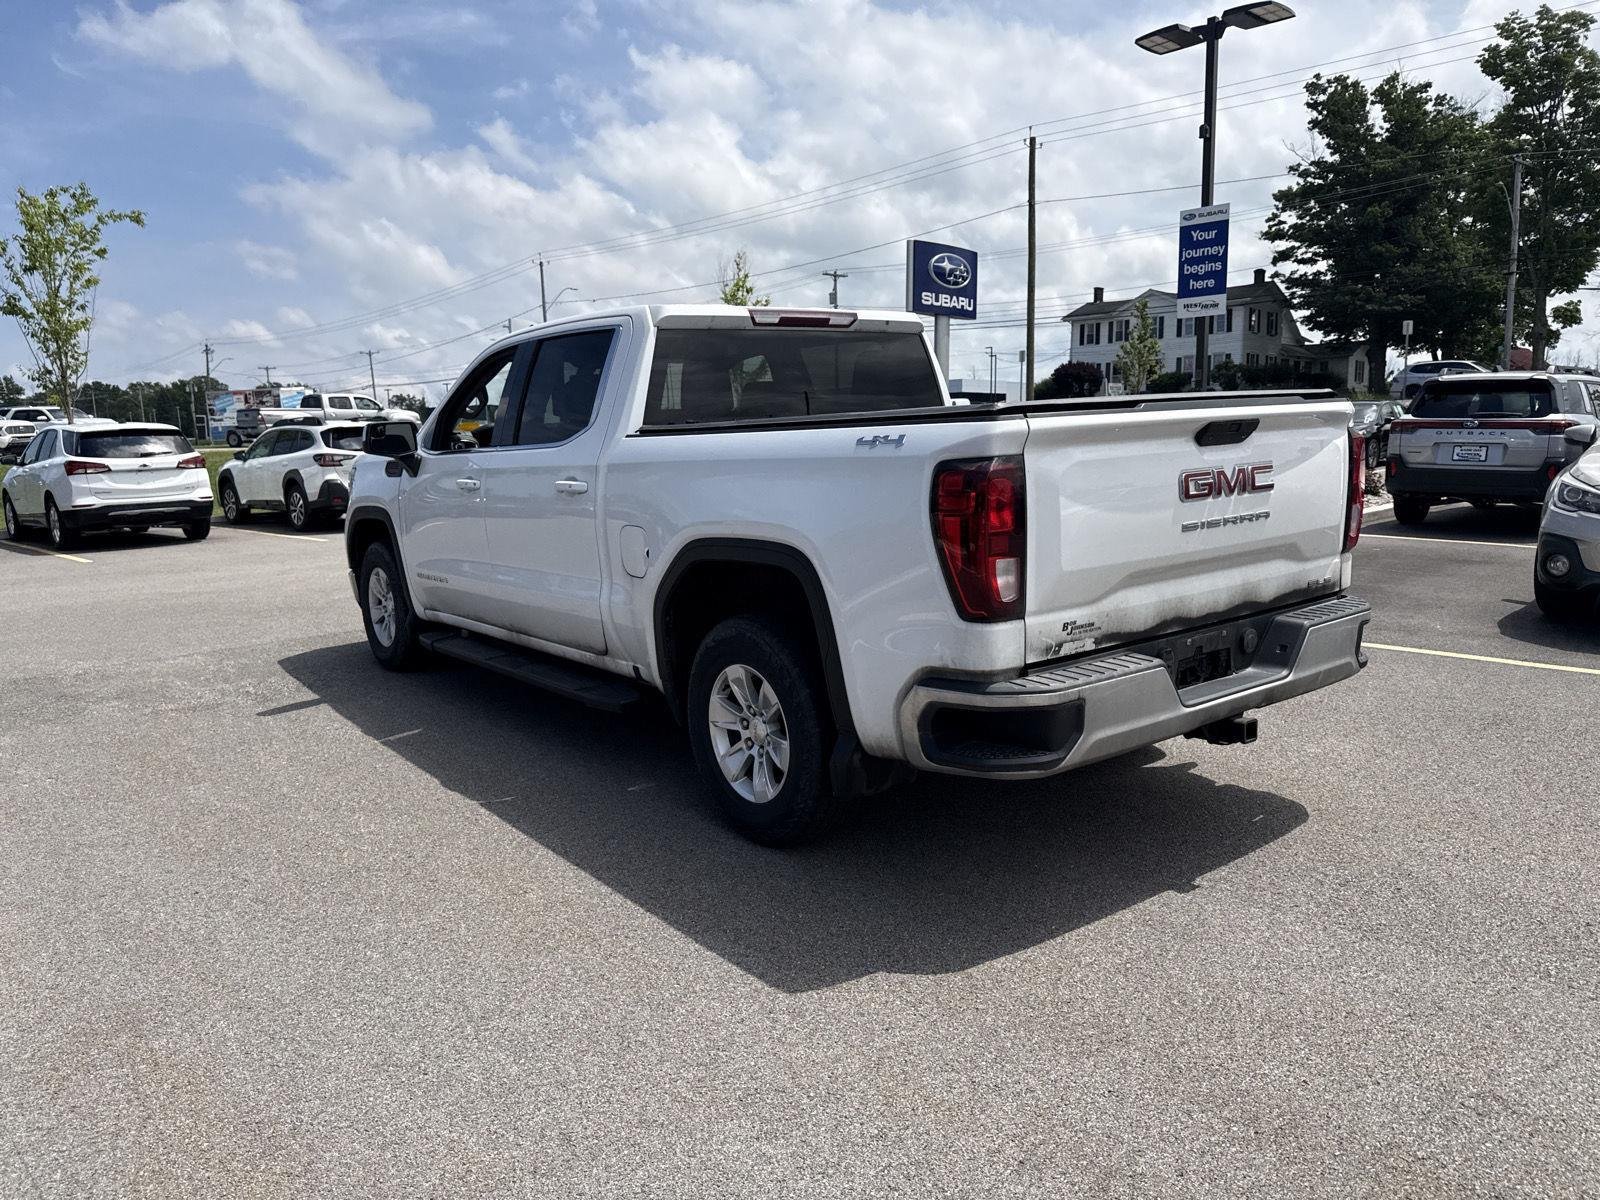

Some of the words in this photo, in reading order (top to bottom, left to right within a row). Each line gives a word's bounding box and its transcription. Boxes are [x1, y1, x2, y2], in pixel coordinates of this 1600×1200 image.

[1198, 208, 1228, 219] SUBARU
[1191, 229, 1218, 241] Your
[1181, 245, 1225, 261] journey
[1183, 261, 1222, 276] begins
[1189, 278, 1215, 290] here
[921, 291, 974, 311] SUBARU
[1178, 460, 1275, 503] GMC
[1181, 509, 1271, 533] SIERRA
